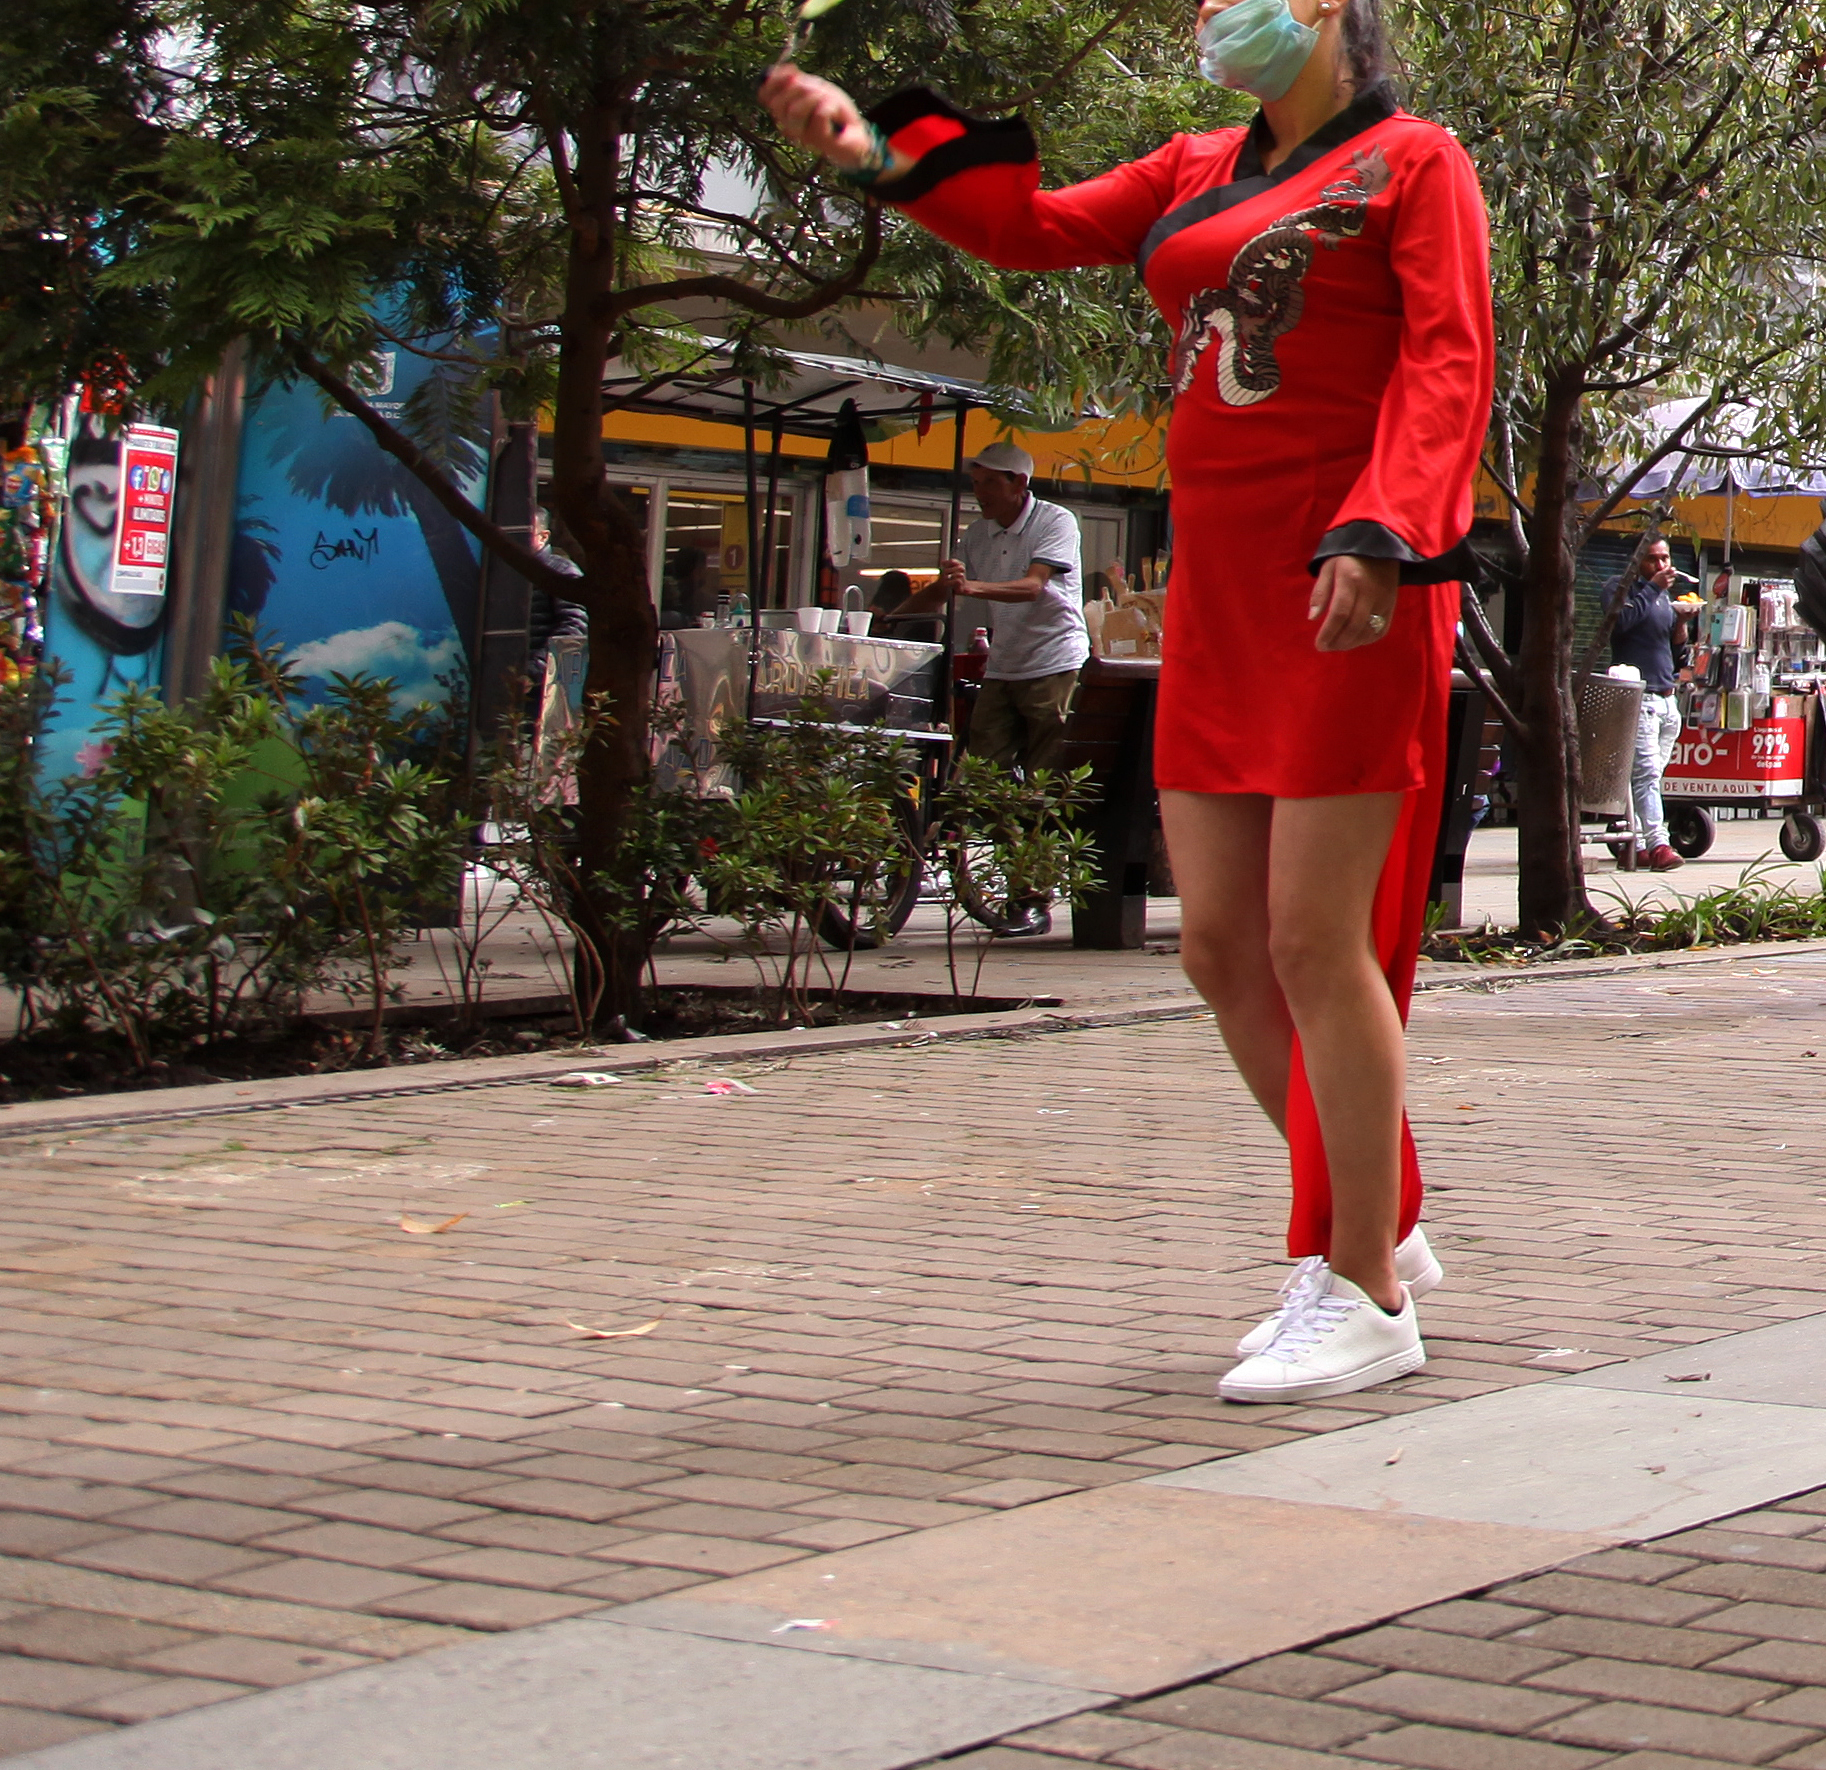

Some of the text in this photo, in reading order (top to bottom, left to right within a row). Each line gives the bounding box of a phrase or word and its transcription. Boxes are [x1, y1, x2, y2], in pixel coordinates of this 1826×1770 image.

[1669, 742, 1713, 766] aro
[1752, 734, 1790, 755] 99%
[1664, 782, 1678, 792] DE
[1682, 783, 1718, 793] VENTA
